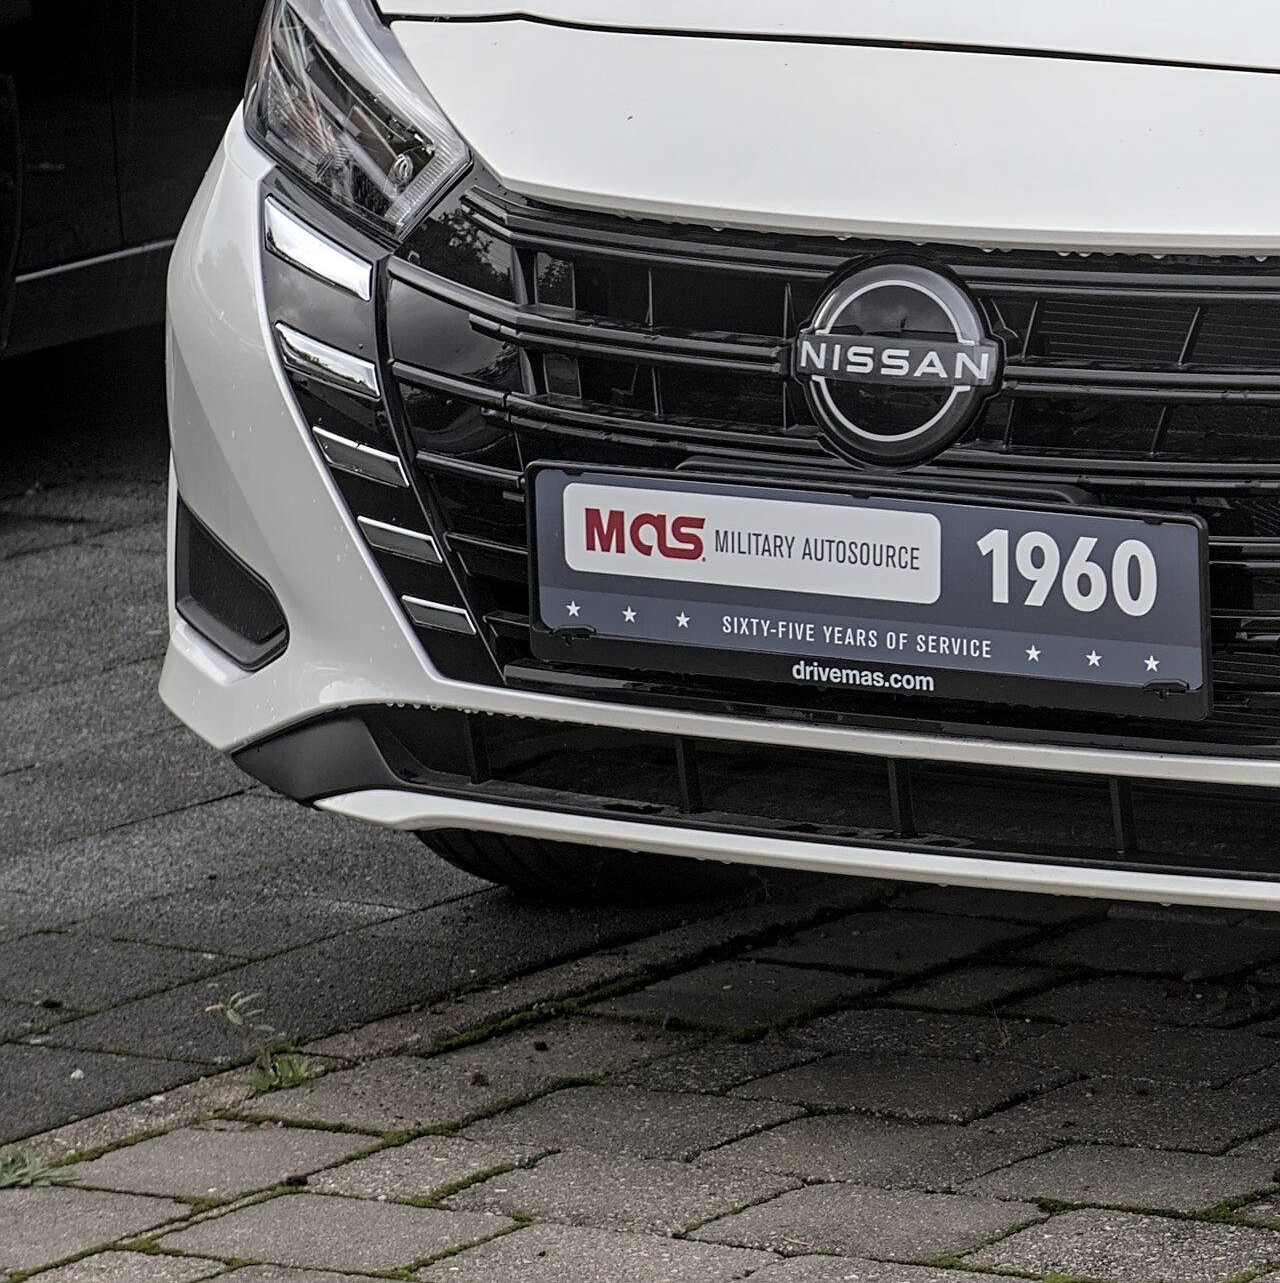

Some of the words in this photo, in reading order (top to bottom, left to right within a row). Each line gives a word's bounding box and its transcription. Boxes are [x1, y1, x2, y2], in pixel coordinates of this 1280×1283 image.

[800, 340, 989, 380] NISSAN
[714, 529, 796, 560] MILITARY
[801, 537, 921, 571] AUTOSOURCE
[976, 528, 1158, 617] 1960
[722, 615, 816, 643] SIXTY-FIVE
[823, 625, 879, 649] YEARS
[886, 631, 909, 651] OF
[916, 634, 993, 659] SERVICE
[791, 660, 936, 692] drivemas.com
